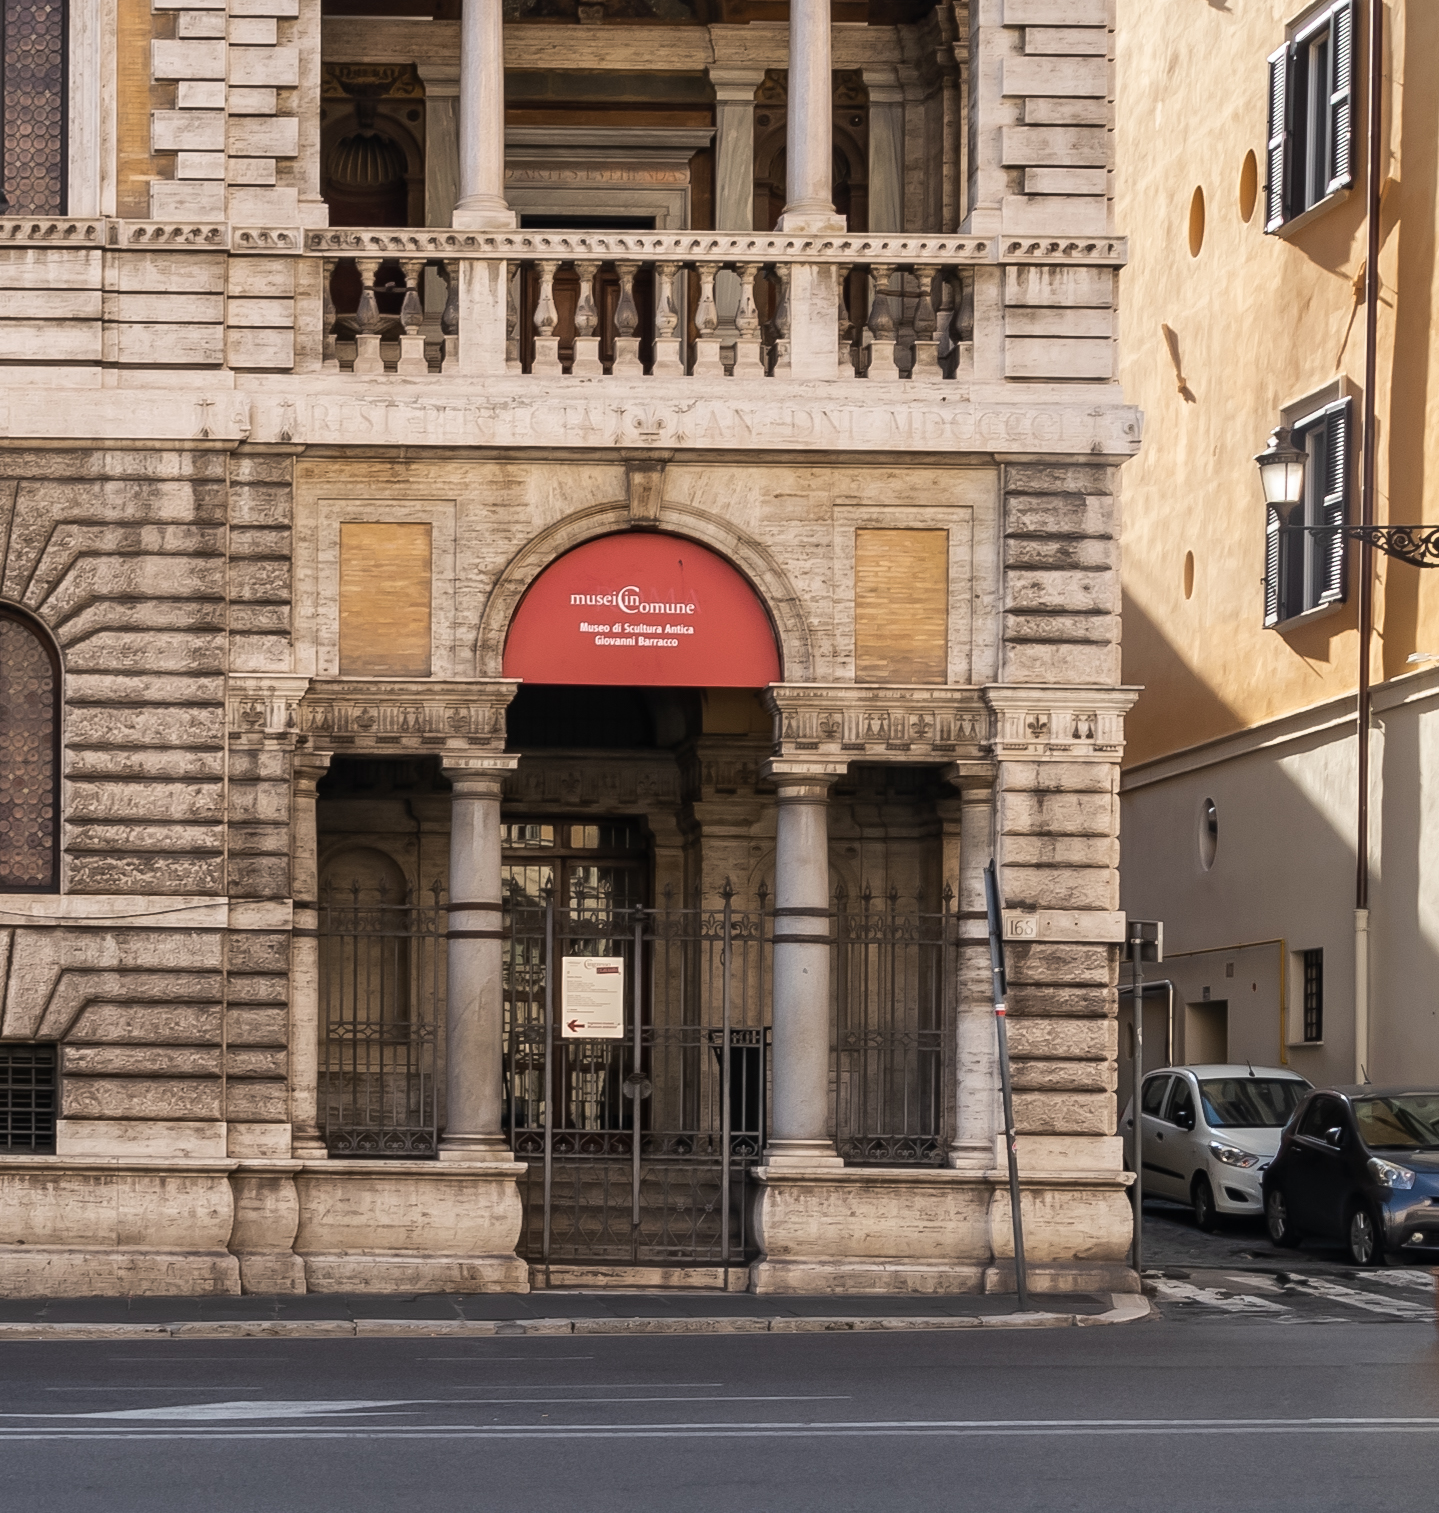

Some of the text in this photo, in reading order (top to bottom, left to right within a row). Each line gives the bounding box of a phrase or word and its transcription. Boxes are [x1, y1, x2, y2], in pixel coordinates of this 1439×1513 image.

[579, 622, 695, 635] Museo di Scultura Antica
[595, 635, 679, 647] Giovanni Barracco
[1010, 919, 1034, 936] 168
